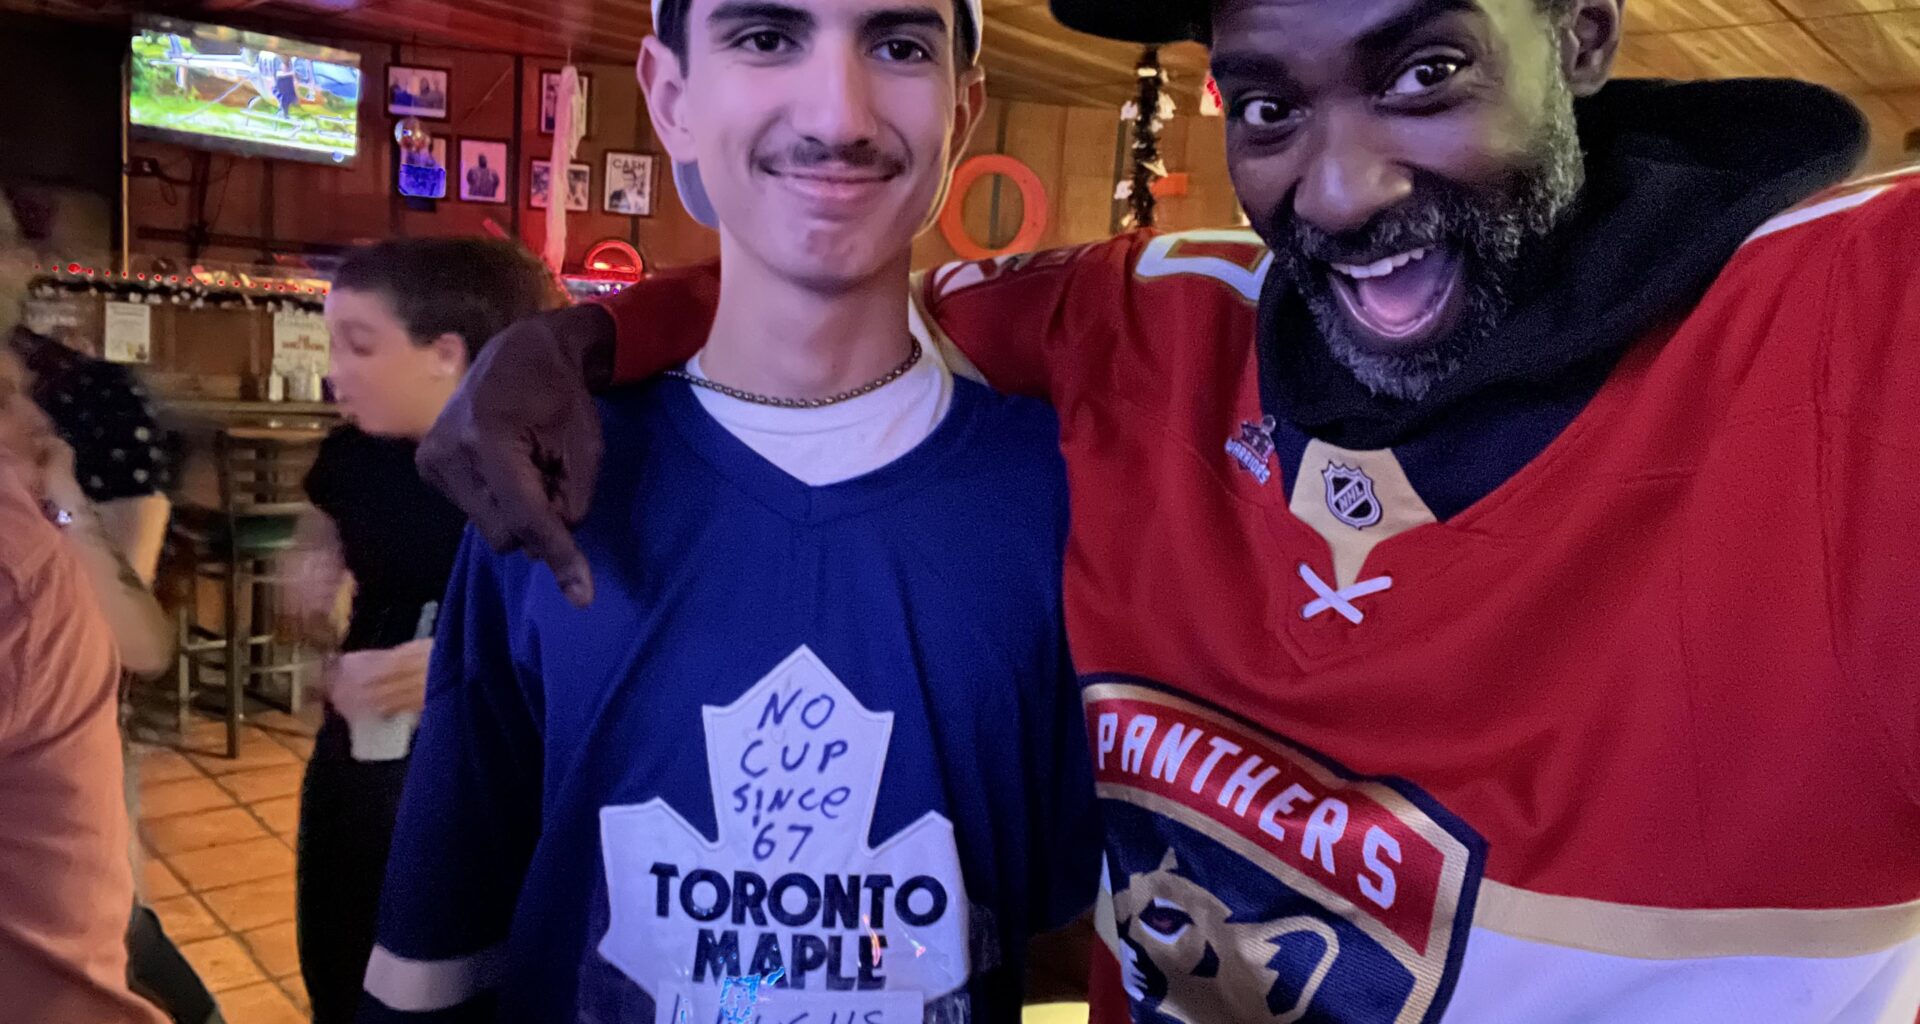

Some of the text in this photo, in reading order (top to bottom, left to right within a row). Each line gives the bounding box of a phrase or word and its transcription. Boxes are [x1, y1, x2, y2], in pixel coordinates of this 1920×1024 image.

[1337, 484, 1364, 513] NHL
[757, 688, 835, 730] NO
[740, 739, 848, 778] CUP
[1097, 712, 1402, 909] PANTHERS
[649, 862, 948, 927] TORONTO
[692, 929, 888, 991] MAPLE
